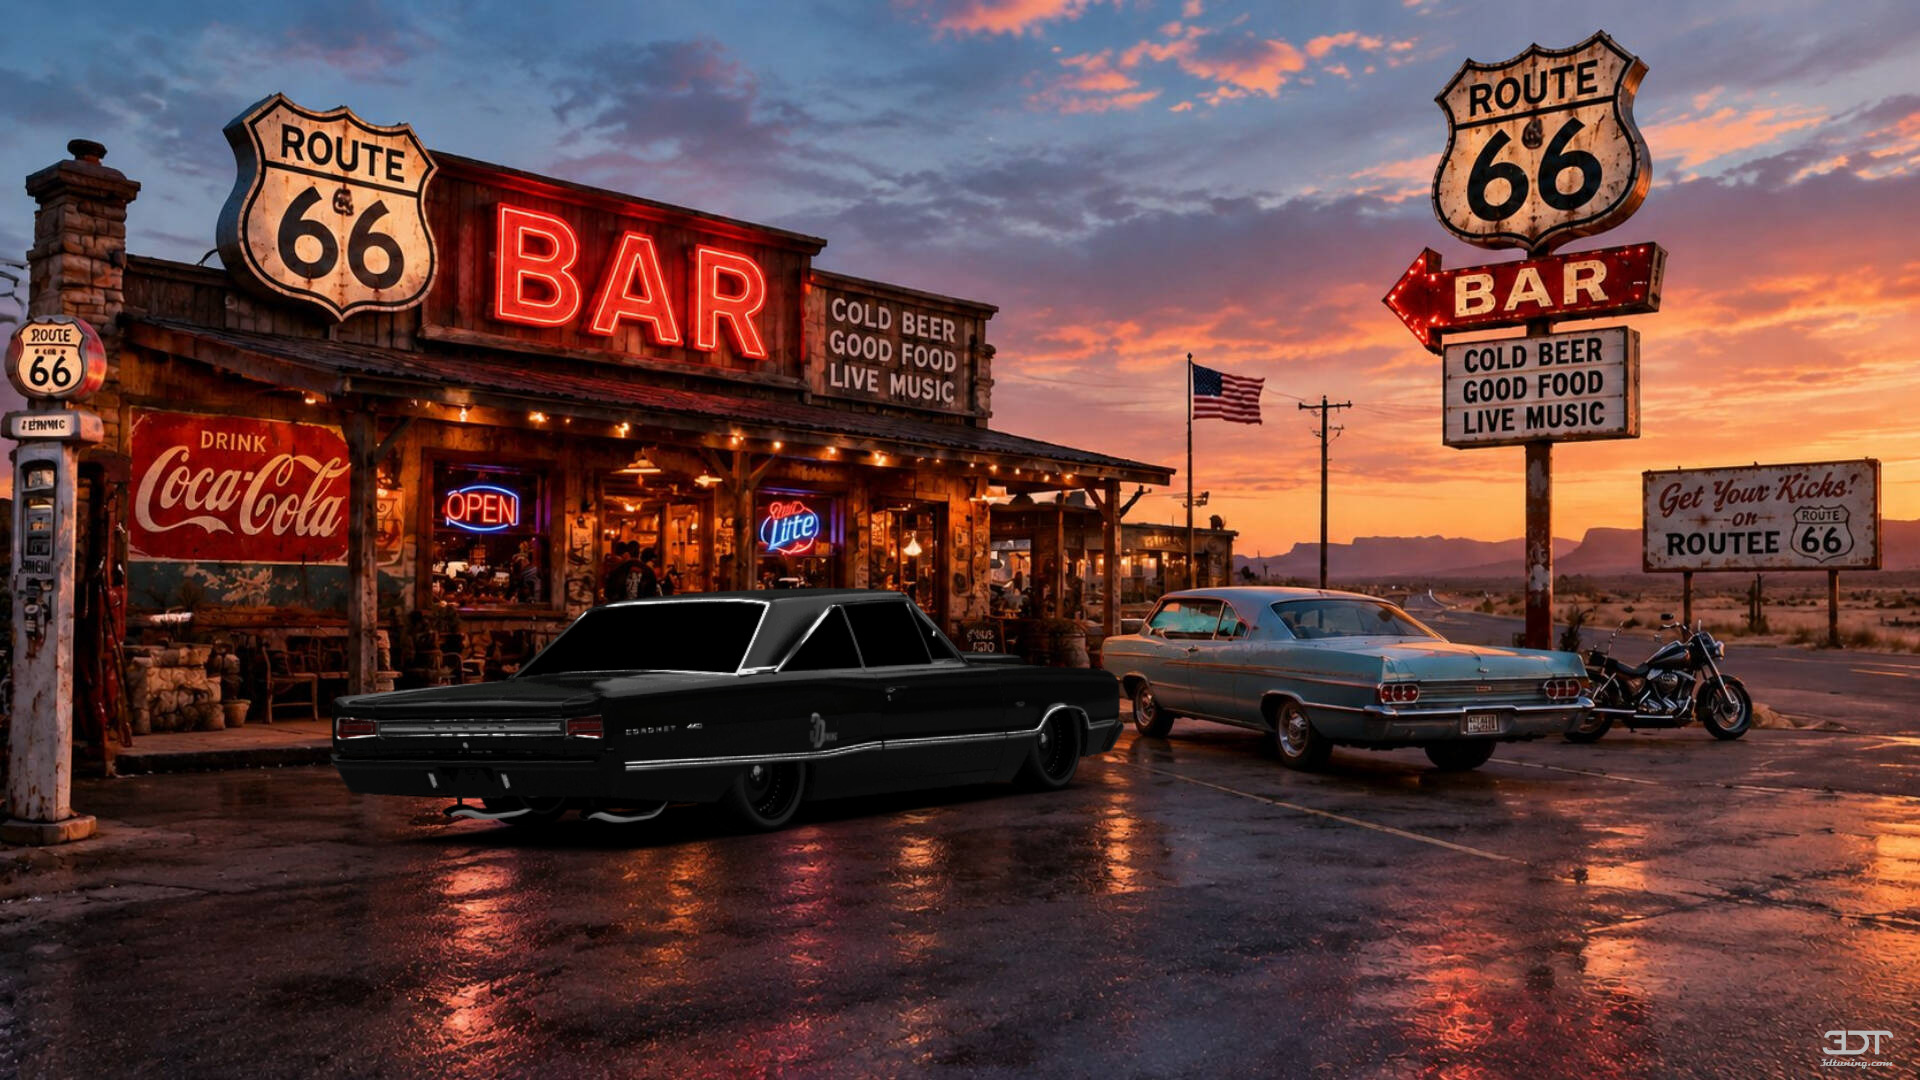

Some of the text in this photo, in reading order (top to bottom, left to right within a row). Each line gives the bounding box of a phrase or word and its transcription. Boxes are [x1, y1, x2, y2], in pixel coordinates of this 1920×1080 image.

[1469, 60, 1599, 117] ROUTE
[281, 123, 405, 183] ROUTE
[1467, 117, 1602, 222] 66
[277, 186, 404, 290] 66
[494, 202, 768, 361] BAR
[1454, 259, 1609, 318] BAR
[31, 328, 72, 342] ROUTE
[831, 297, 956, 344] COLD BEER
[29, 356, 71, 386] 66
[829, 329, 957, 373] GOOD FOOD
[1464, 337, 1602, 373] COLD BEER
[829, 362, 955, 403] LIVE MUSIC
[1463, 370, 1604, 404] GOOD FOOD
[1463, 401, 1605, 434] LIVE MUSIC
[201, 430, 267, 453] DRINK
[135, 445, 351, 537] Coca-Cola
[447, 493, 515, 524] OPEN
[1658, 471, 1858, 518] Get Your Kicks!
[1802, 510, 1840, 521] ROUTE
[1665, 531, 1780, 556] ROUTEE
[1801, 526, 1842, 554] 66
